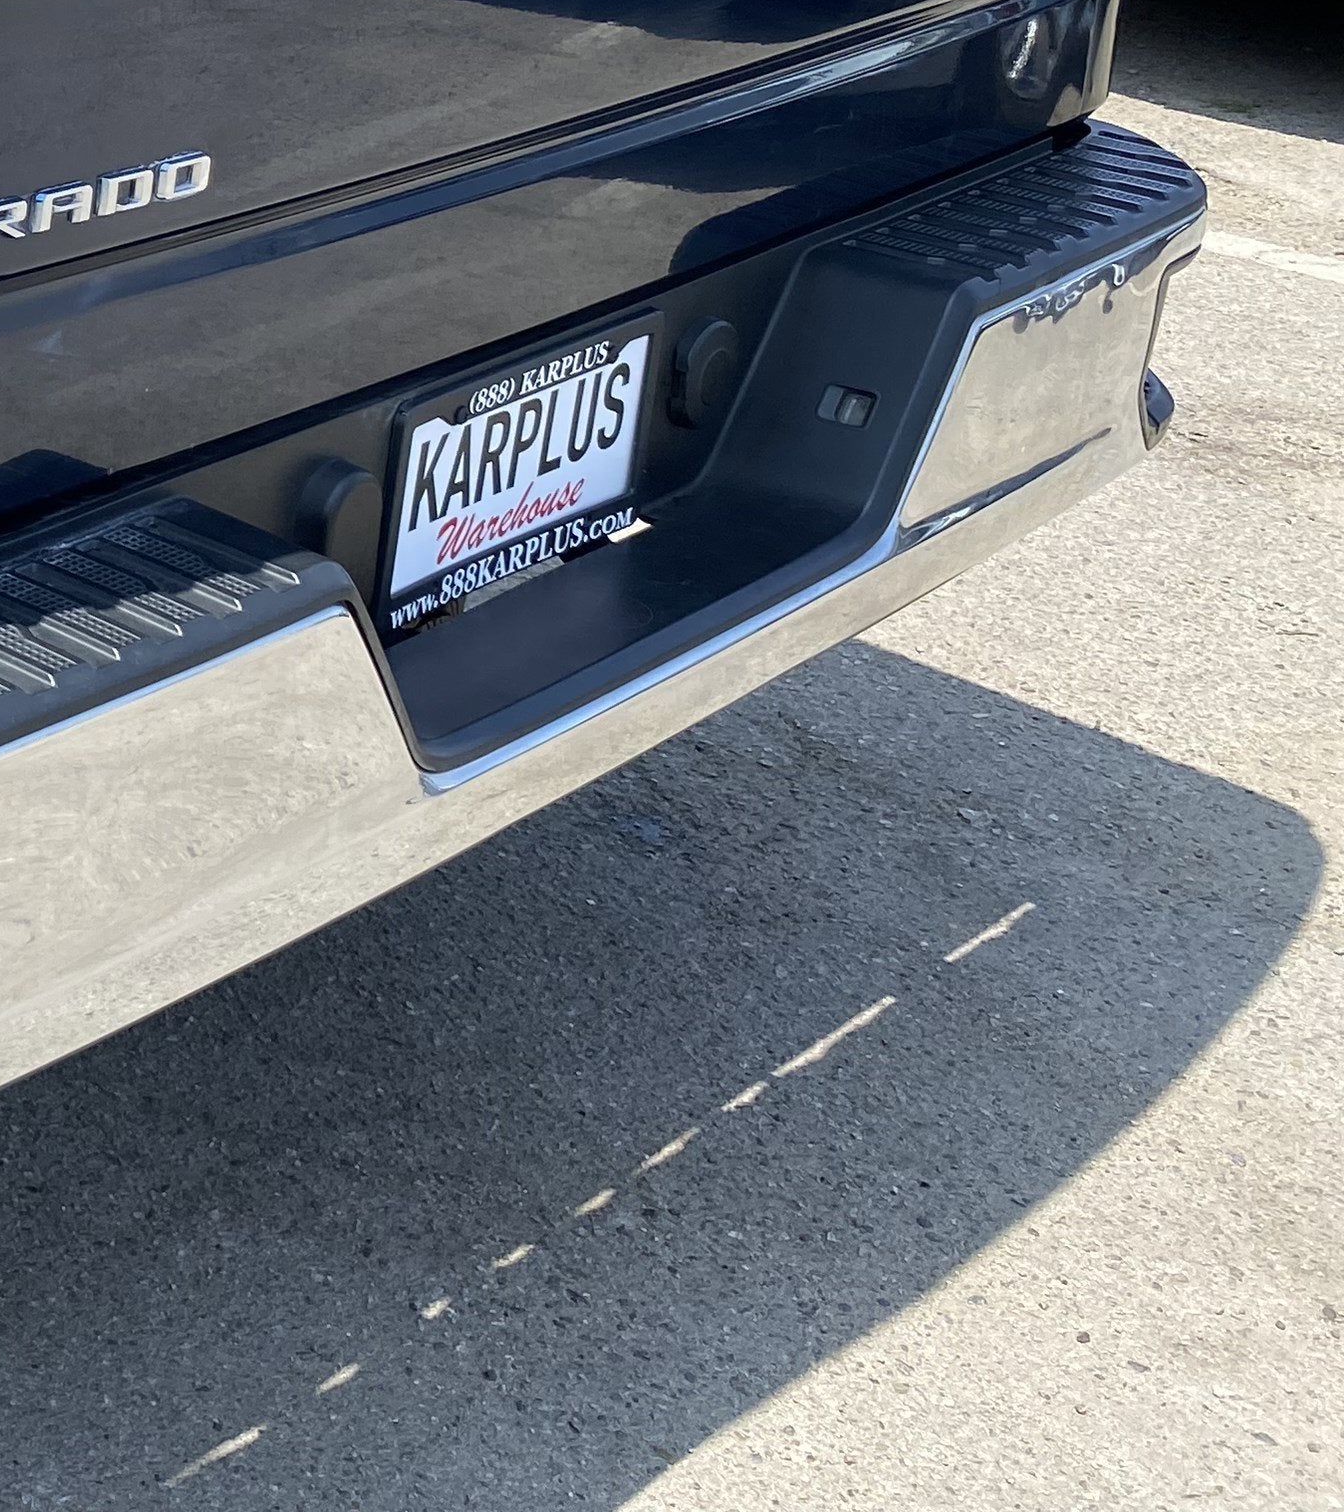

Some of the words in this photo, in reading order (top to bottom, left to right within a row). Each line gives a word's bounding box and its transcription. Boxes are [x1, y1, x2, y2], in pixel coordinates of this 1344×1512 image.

[468, 378, 516, 416] (888)
[519, 340, 610, 396] KARPLUS
[407, 362, 631, 532] KARPLUS
[436, 478, 585, 565] Warehouse
